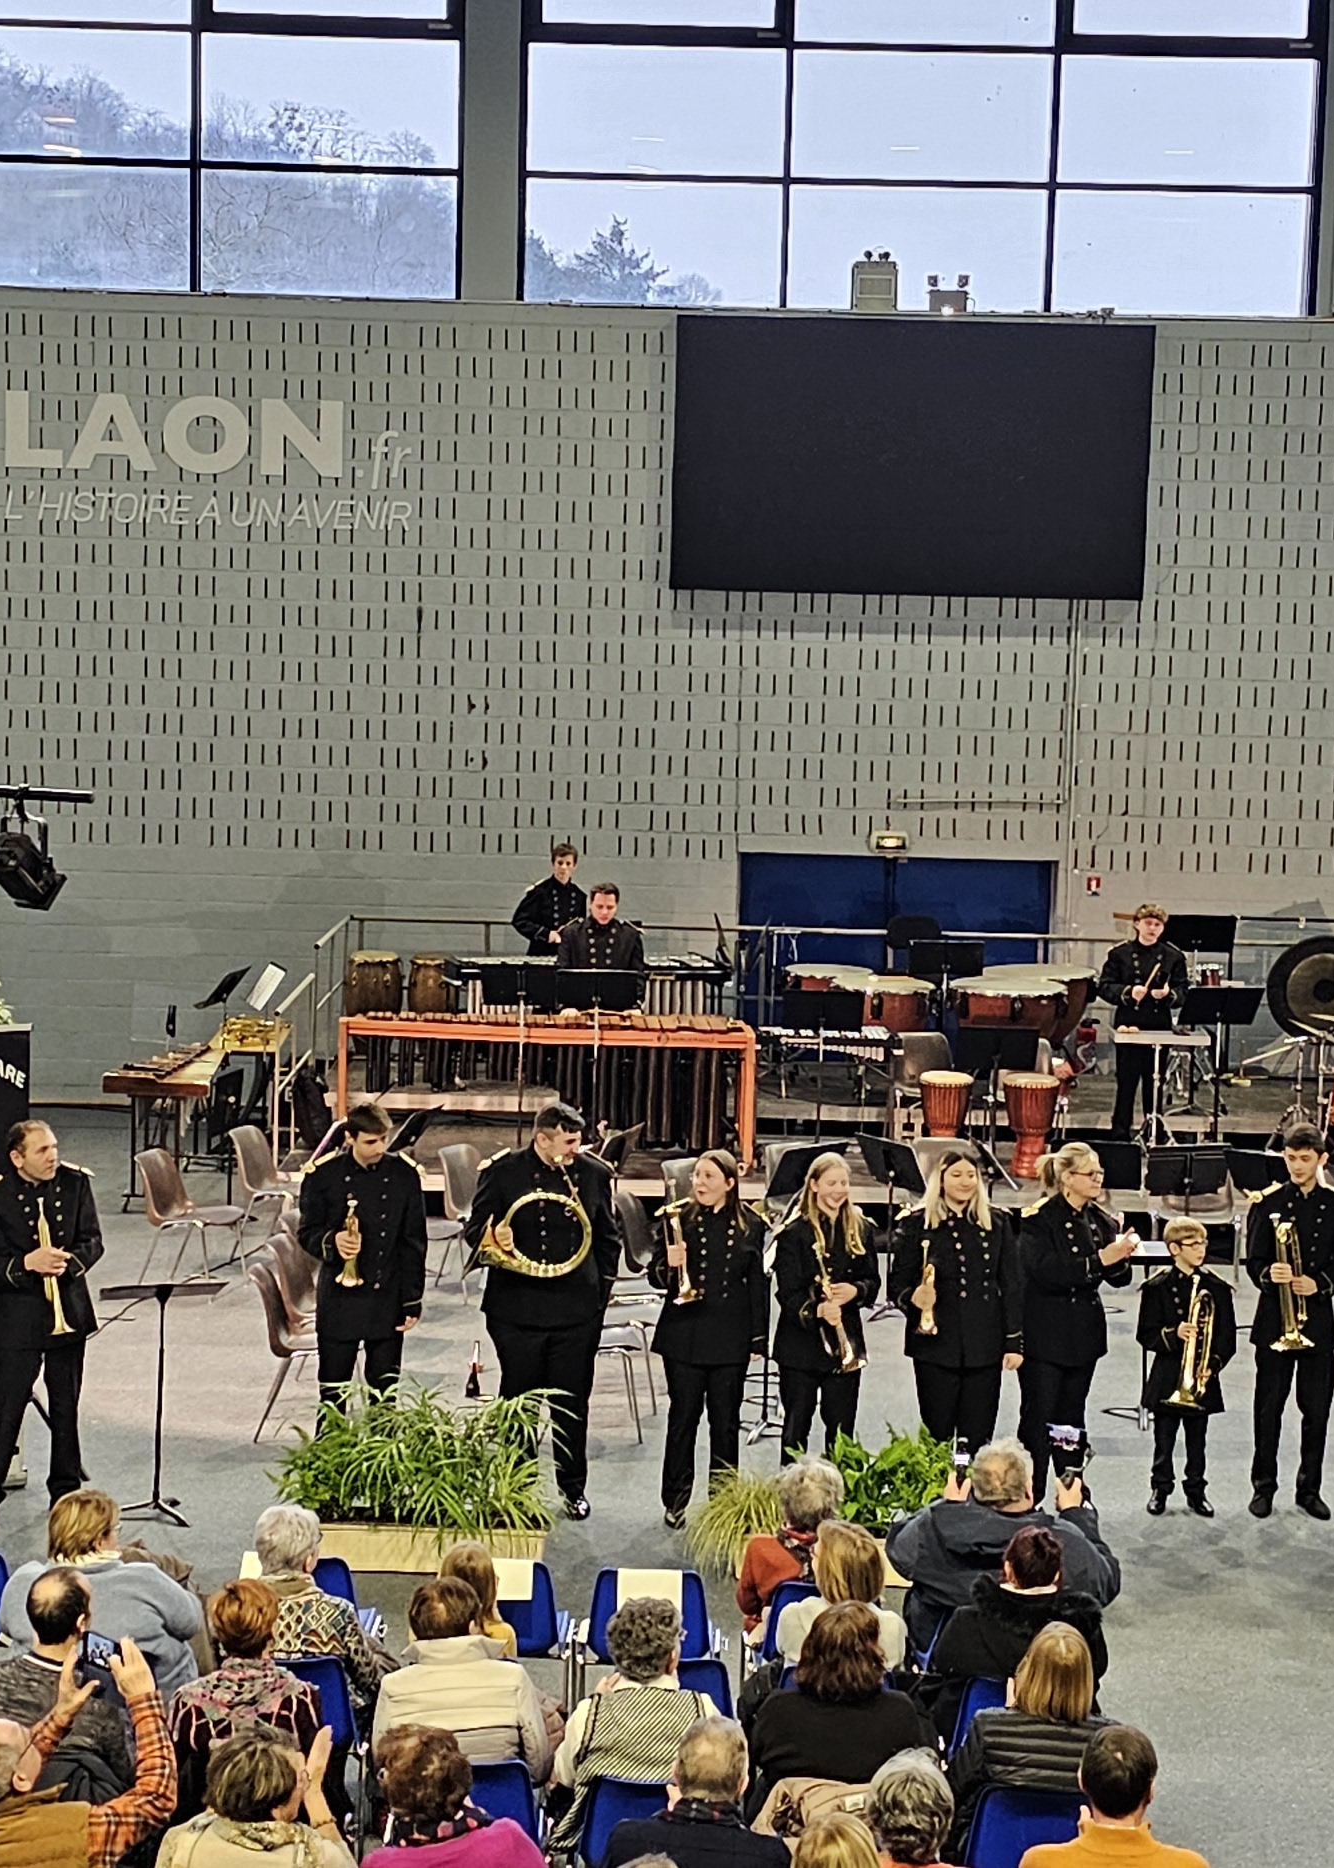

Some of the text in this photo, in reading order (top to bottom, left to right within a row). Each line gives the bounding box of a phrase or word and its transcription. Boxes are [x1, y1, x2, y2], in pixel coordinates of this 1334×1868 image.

[4, 489, 413, 532] L'HISTOIRE A UN AVENIR
